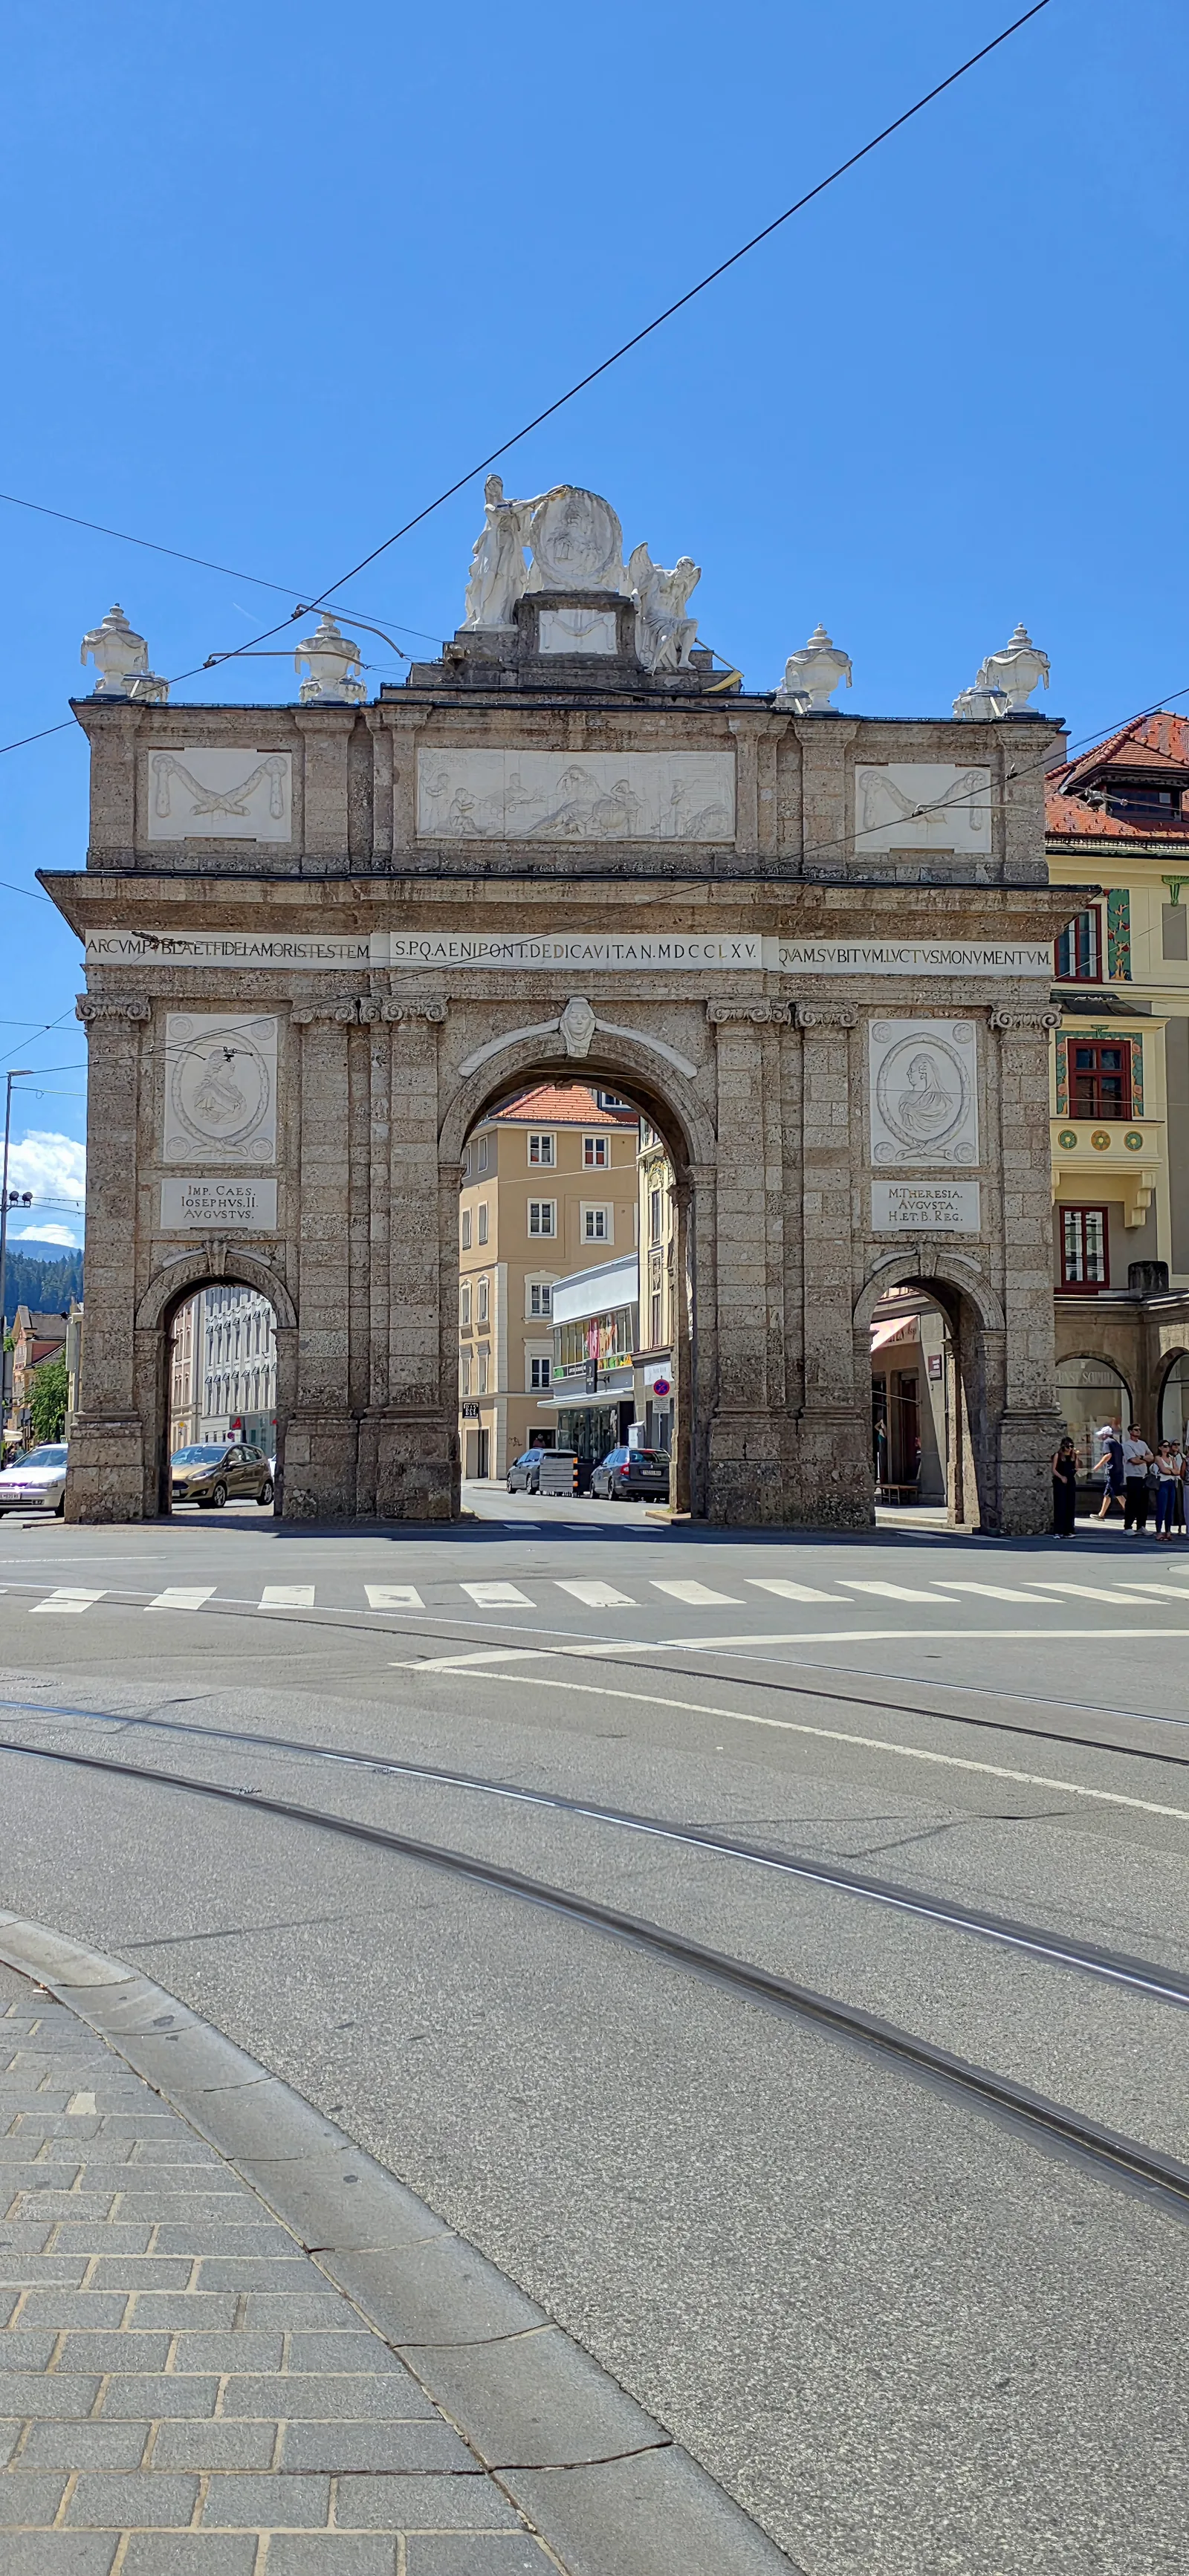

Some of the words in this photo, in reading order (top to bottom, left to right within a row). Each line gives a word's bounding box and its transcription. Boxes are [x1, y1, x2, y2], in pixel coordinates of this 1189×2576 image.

[216, 1185, 256, 1196] CAES.
[898, 1199, 958, 1210] AVGVSTA.
[184, 1209, 254, 1219] AVGVSTVS.
